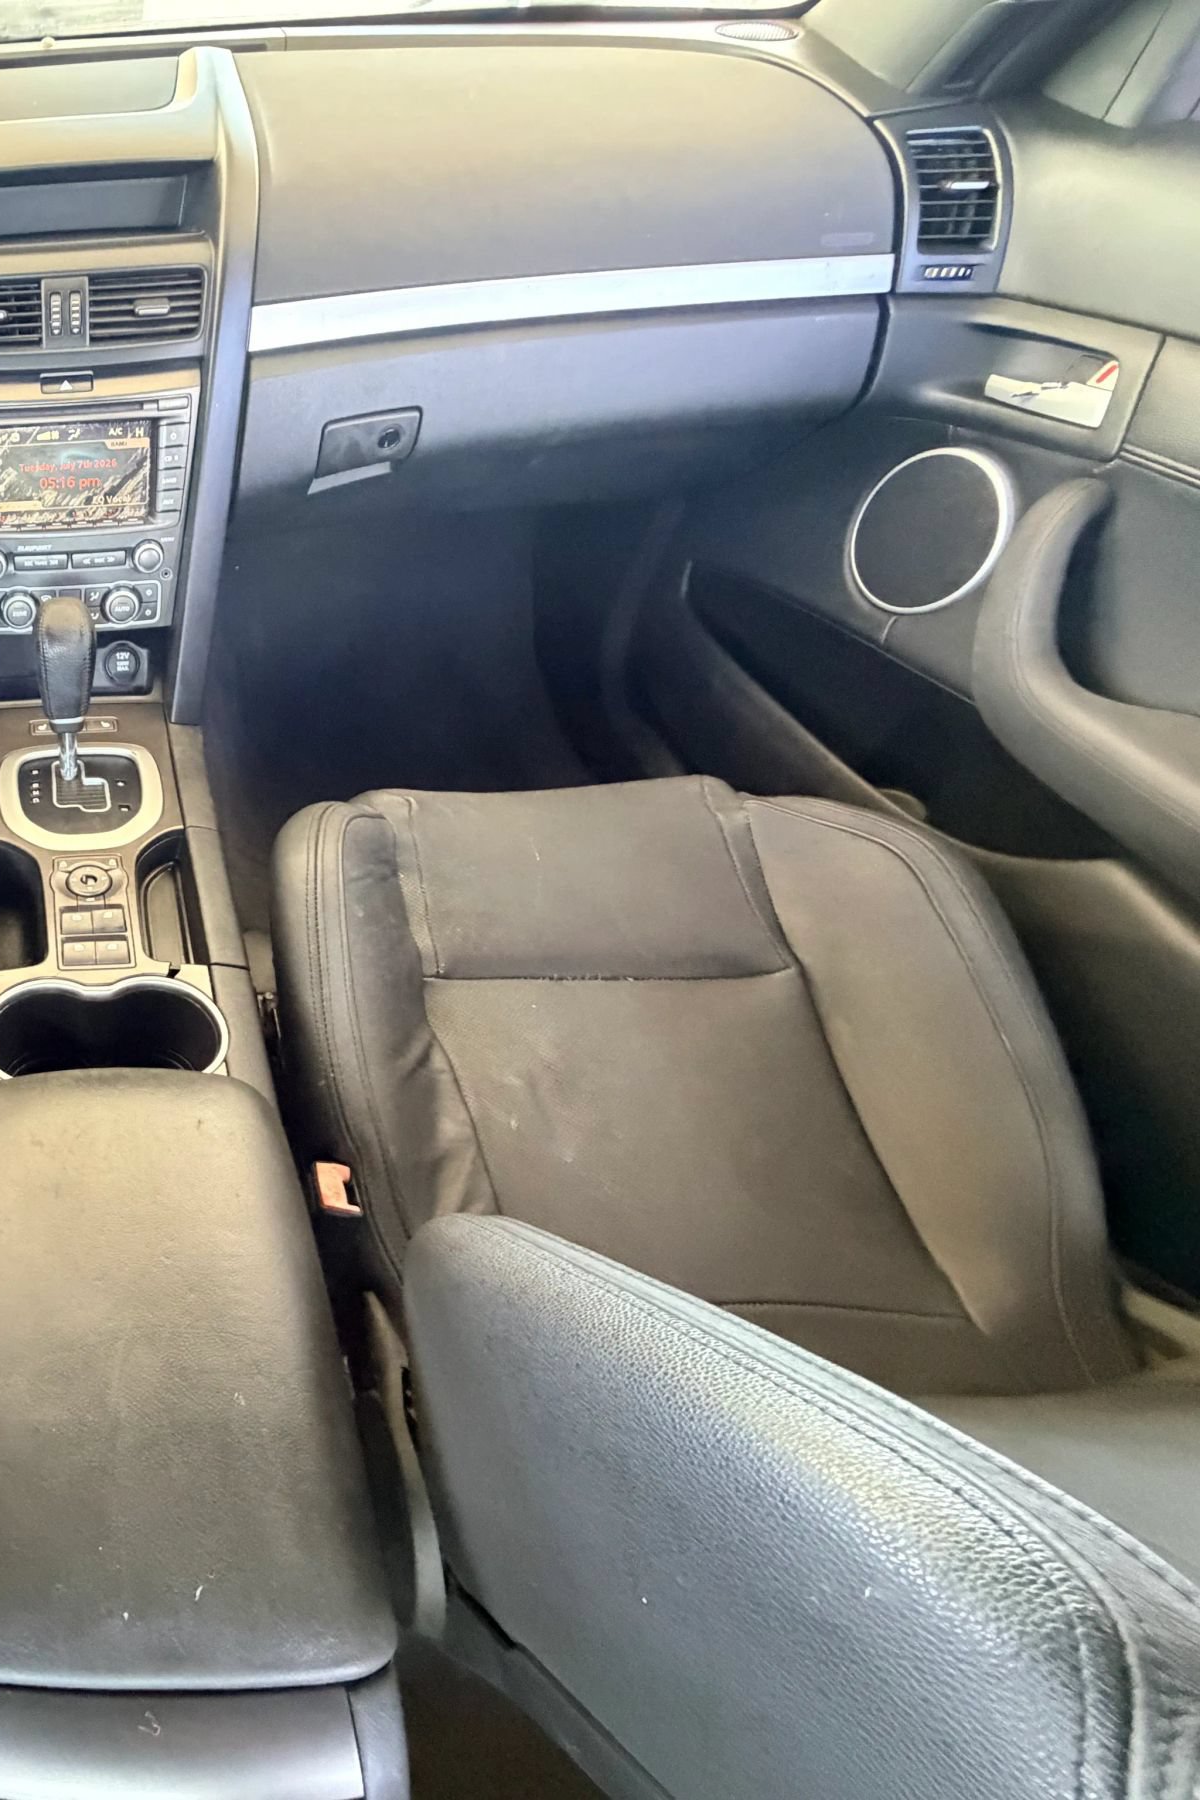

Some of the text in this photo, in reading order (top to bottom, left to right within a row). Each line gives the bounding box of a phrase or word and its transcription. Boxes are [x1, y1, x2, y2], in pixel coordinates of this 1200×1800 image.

[109, 427, 123, 436] A/C
[19, 458, 118, 473] Tuesday, July 7th 2026
[40, 476, 102, 489] 05:16 pm
[116, 652, 130, 660] 12V
